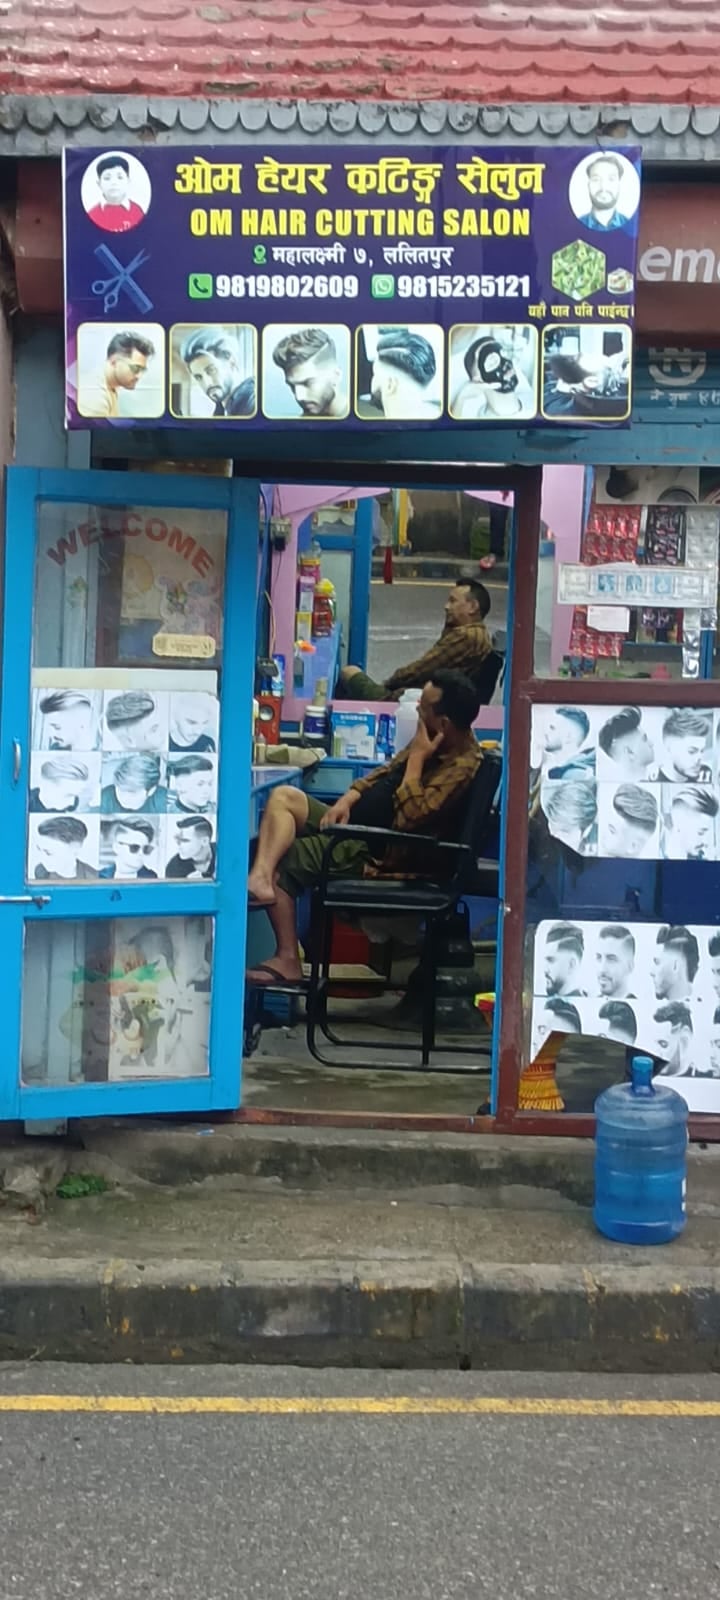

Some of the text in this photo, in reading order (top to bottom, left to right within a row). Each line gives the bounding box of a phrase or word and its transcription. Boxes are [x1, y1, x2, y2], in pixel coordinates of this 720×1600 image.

[175, 157, 242, 194] ओम
[255, 156, 331, 195] हेयर
[456, 156, 545, 201] सेलुन
[190, 208, 530, 237] OM HAIR CUTTING SALON
[382, 241, 455, 270] ललितपुर
[640, 246, 720, 283] em
[215, 274, 359, 298] 9819802609
[397, 274, 530, 298] 9815235121
[46, 512, 215, 579] WELCOME
